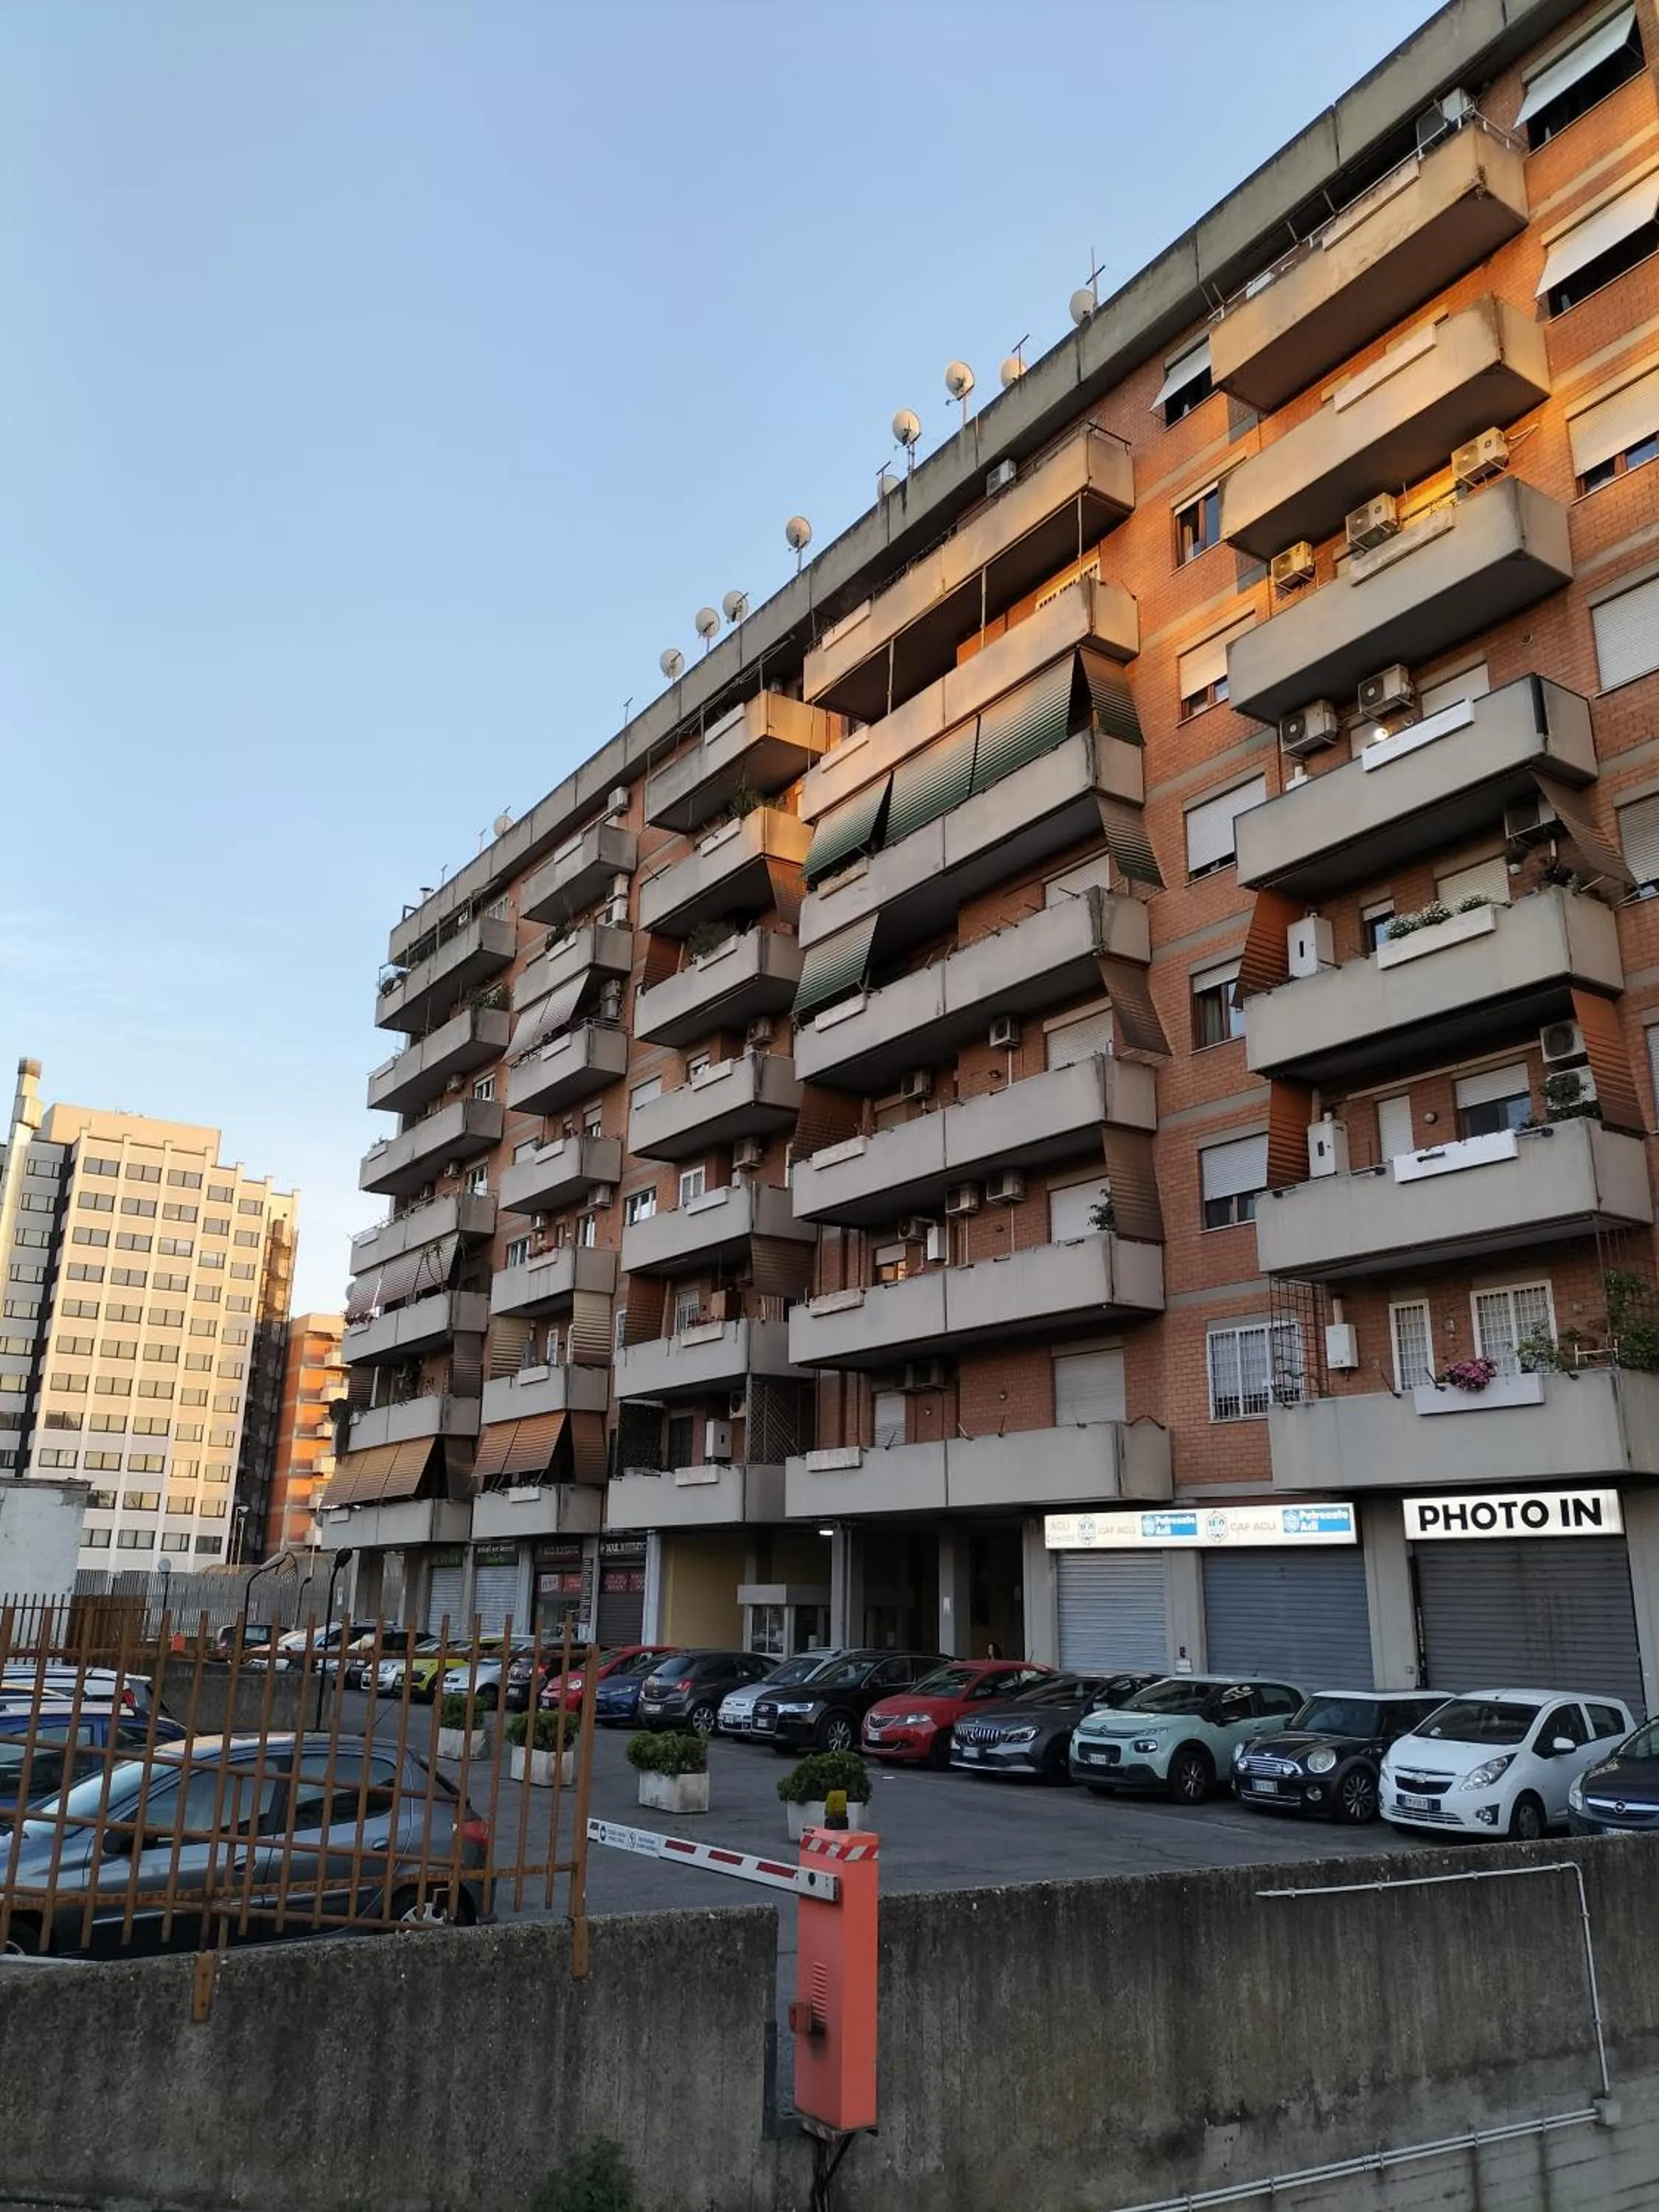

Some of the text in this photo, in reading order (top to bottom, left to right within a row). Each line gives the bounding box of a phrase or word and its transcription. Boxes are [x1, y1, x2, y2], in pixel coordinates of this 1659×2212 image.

[1418, 1498, 1603, 1531] PHOTO IN
[1098, 1526, 1114, 1535] CAF
[1229, 1521, 1276, 1532] CAF ACLI
